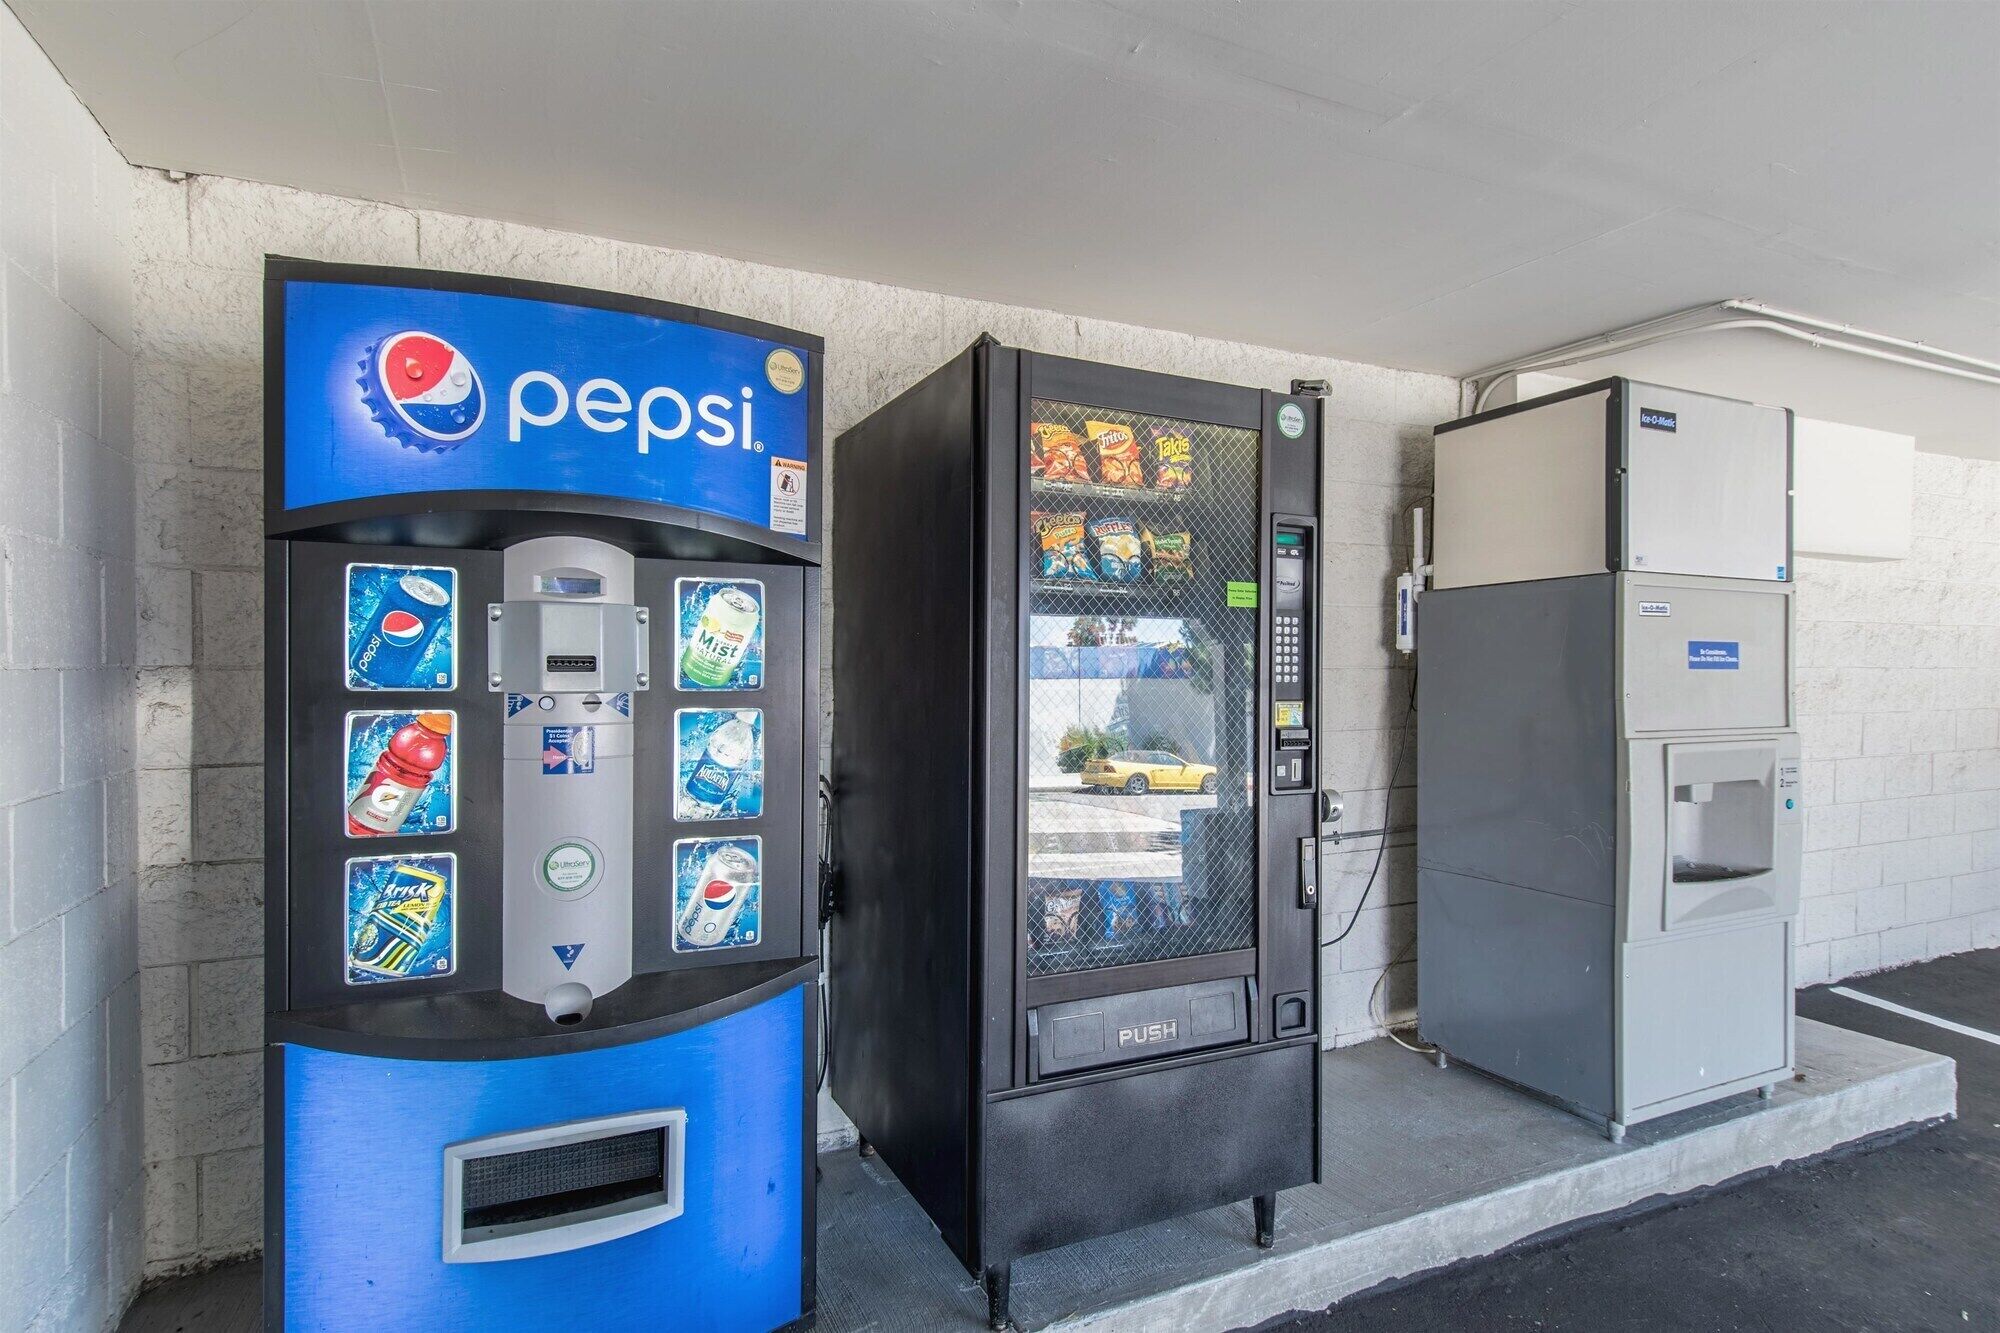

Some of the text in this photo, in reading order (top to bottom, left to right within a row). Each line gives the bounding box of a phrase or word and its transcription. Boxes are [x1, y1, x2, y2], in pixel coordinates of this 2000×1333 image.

[509, 370, 753, 454] pepsi
[1641, 413, 1676, 428] Ice-O-Matic
[1099, 429, 1129, 449] Fritos
[1155, 436, 1191, 461] Takis
[782, 462, 805, 471] WARNING
[1035, 513, 1082, 537] Cheetos
[1093, 520, 1134, 537] RUFFLES
[359, 633, 383, 673] pepsi
[698, 629, 739, 658] Mist
[1780, 778, 1784, 788] 2
[685, 902, 704, 936] pepsi
[1119, 1022, 1176, 1046] PUSH
